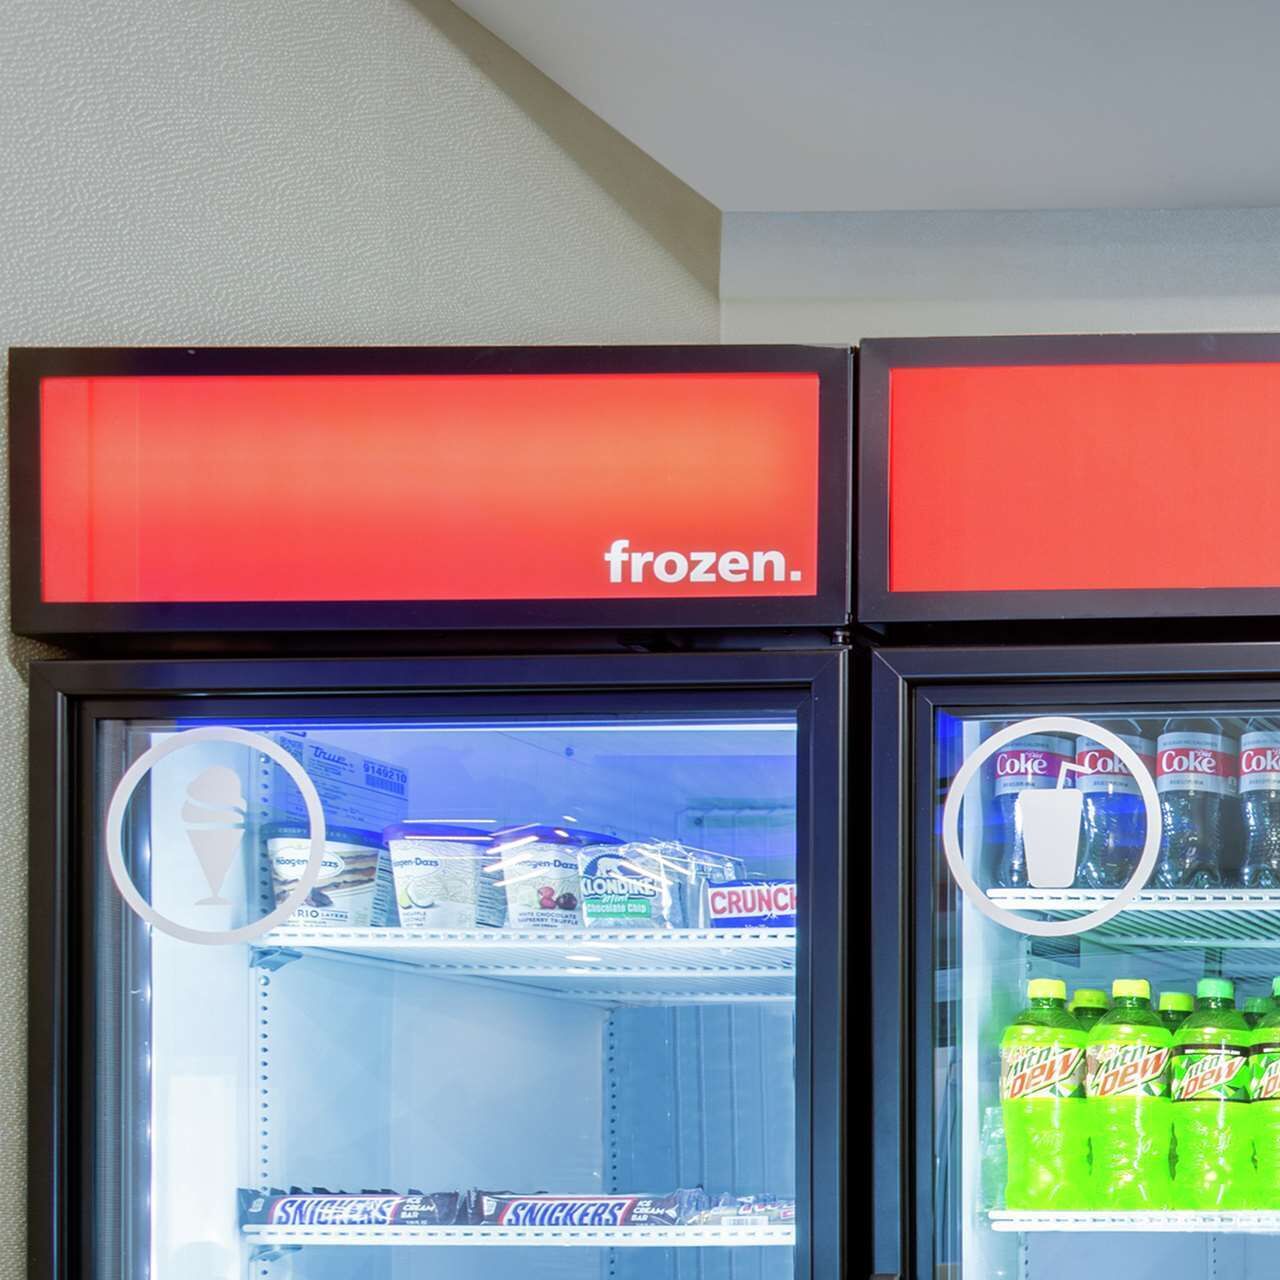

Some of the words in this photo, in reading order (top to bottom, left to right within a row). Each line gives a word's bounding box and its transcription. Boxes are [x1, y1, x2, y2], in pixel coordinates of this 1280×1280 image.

[603, 538, 803, 584] frozen.
[996, 754, 1048, 776] Coke
[1162, 751, 1216, 773] Coke
[505, 1202, 626, 1225] SNICKERS
